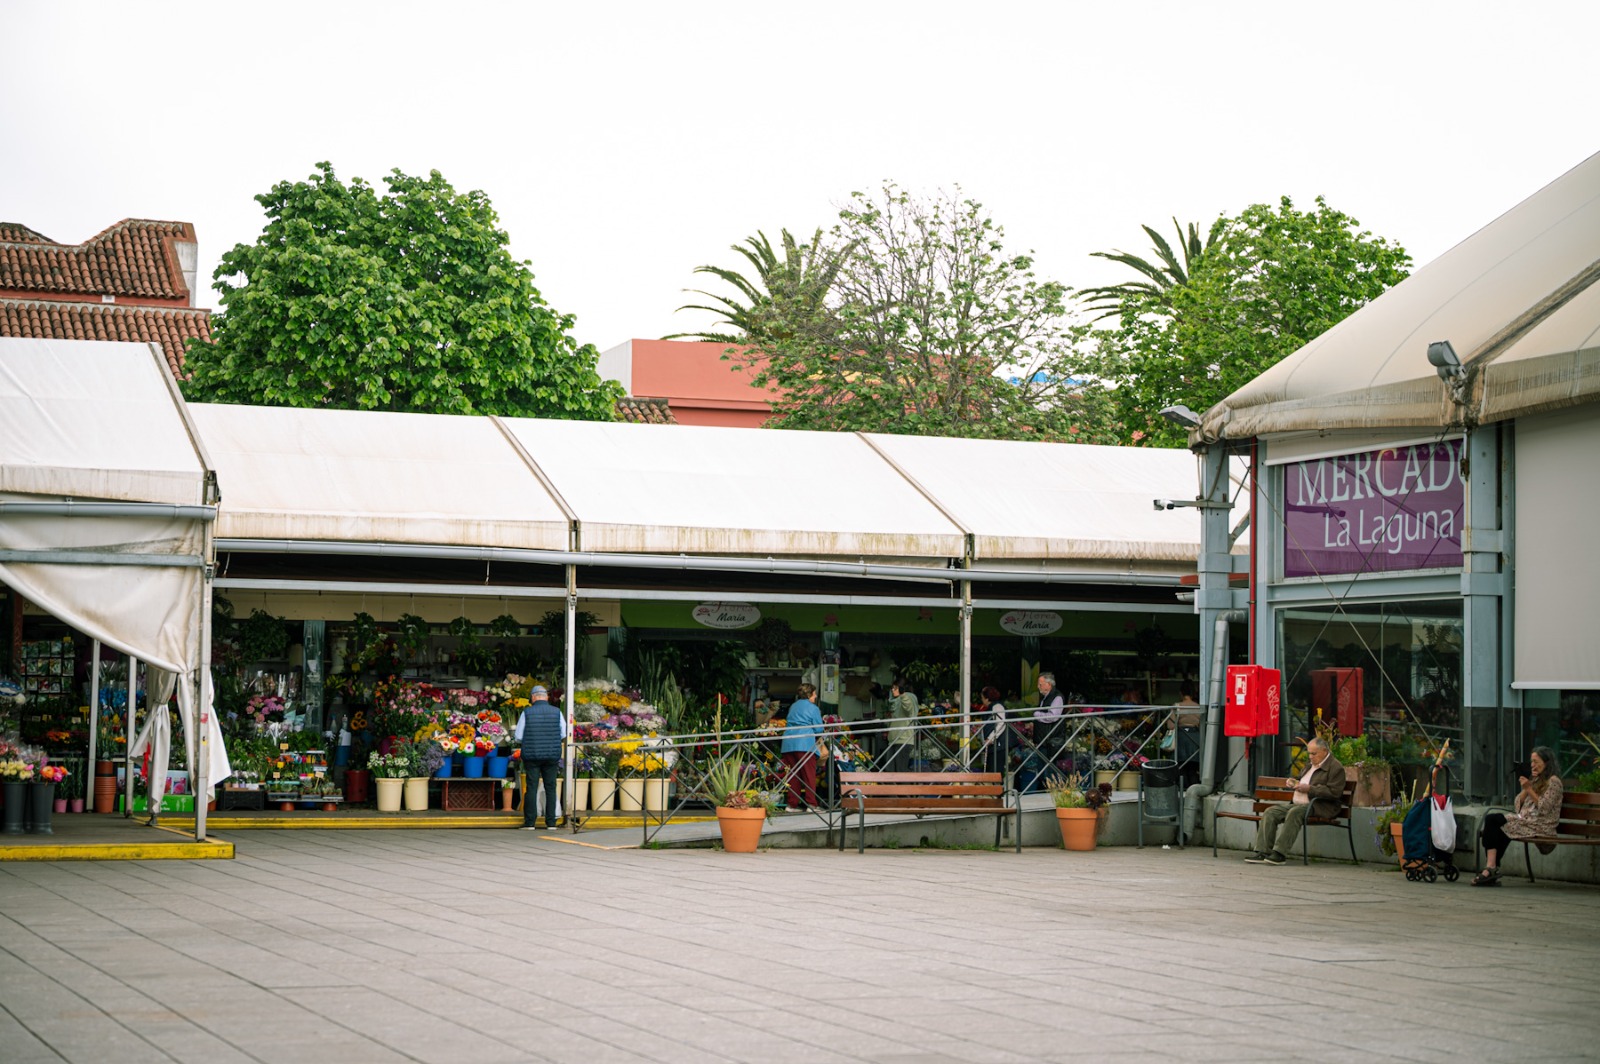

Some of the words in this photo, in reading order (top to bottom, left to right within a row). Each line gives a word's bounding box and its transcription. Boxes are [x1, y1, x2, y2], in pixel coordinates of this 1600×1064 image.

[1296, 441, 1465, 506] MERCAD
[1325, 513, 1350, 547] La
[1359, 509, 1454, 554] Laguna
